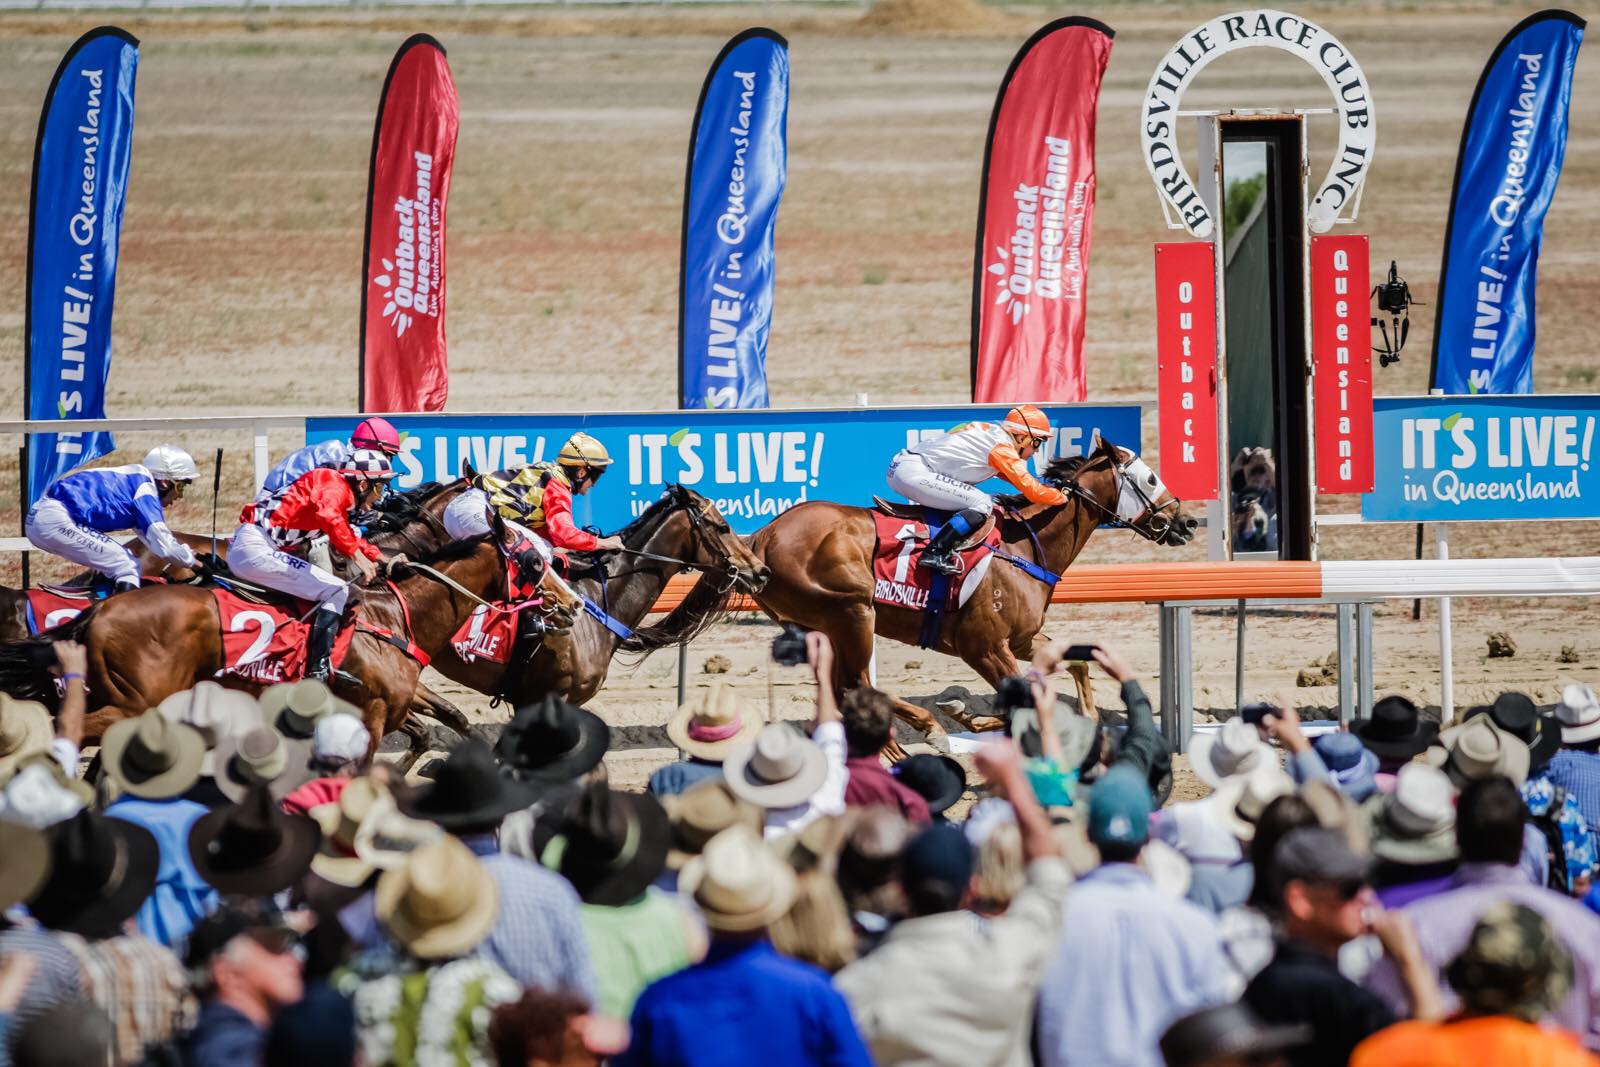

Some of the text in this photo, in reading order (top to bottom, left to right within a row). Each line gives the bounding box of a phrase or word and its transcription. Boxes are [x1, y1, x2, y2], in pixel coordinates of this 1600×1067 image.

[69, 69, 103, 245] Queensland
[716, 70, 757, 245] Queensland
[1146, 13, 1369, 232] BIRDSVILLE RACE CLUB INC.
[1490, 53, 1544, 227] Queensland
[394, 196, 414, 308] Outback
[414, 151, 433, 314] Queensland
[430, 198, 441, 226] story
[1009, 182, 1039, 296] Outback
[1035, 135, 1071, 299] Queensland
[1490, 233, 1513, 261] in
[72, 253, 94, 280] in
[427, 292, 439, 318] Live
[719, 252, 744, 279] in
[1470, 265, 1508, 360] LIVE!
[60, 285, 94, 382] LIVE!
[706, 283, 746, 378] LIVE!
[1178, 281, 1196, 463] Outback
[1333, 249, 1352, 481] Queensland
[628, 428, 825, 488] IT'S LIVE!
[1402, 412, 1596, 472] IT'S LIVE!
[1404, 469, 1581, 505] in Queensland
[894, 524, 917, 583] 1
[230, 610, 276, 668] 2
